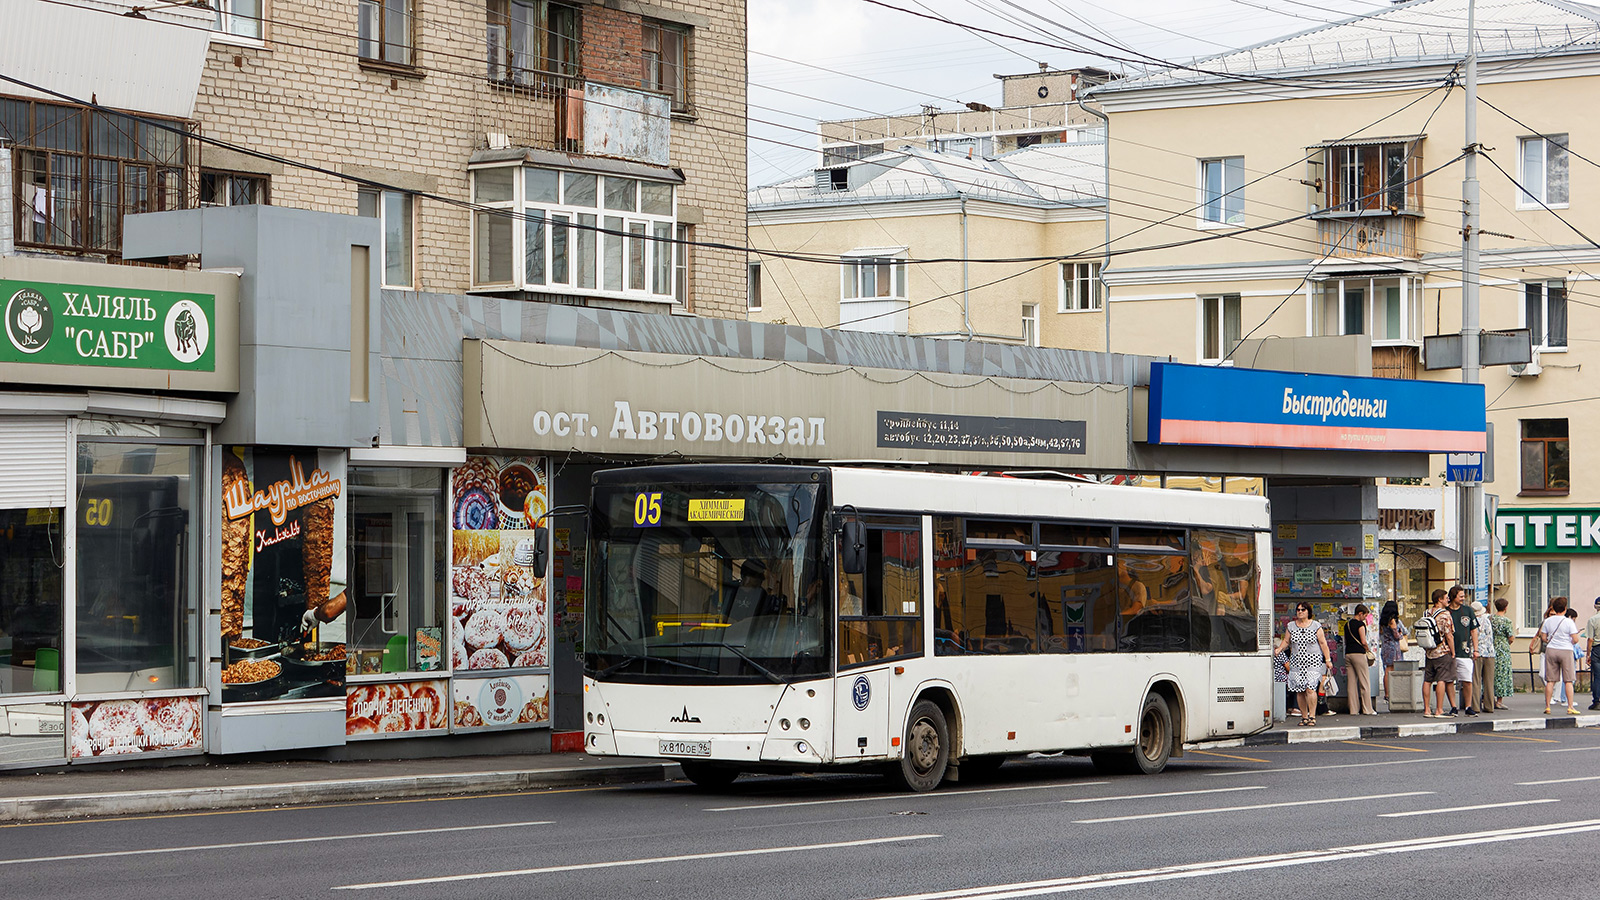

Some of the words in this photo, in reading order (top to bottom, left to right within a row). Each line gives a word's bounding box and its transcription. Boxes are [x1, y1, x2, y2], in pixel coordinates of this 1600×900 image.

[62, 292, 157, 321] ХАЛЯЛЬ
[64, 327, 155, 360] "САБР"
[1282, 387, 1387, 421] Быстроденьги
[533, 410, 599, 438] ост.
[609, 401, 827, 446] Автовокзал
[634, 492, 662, 525] 05
[689, 508, 744, 520] АКАДЕМИЧЕСКИЙ
